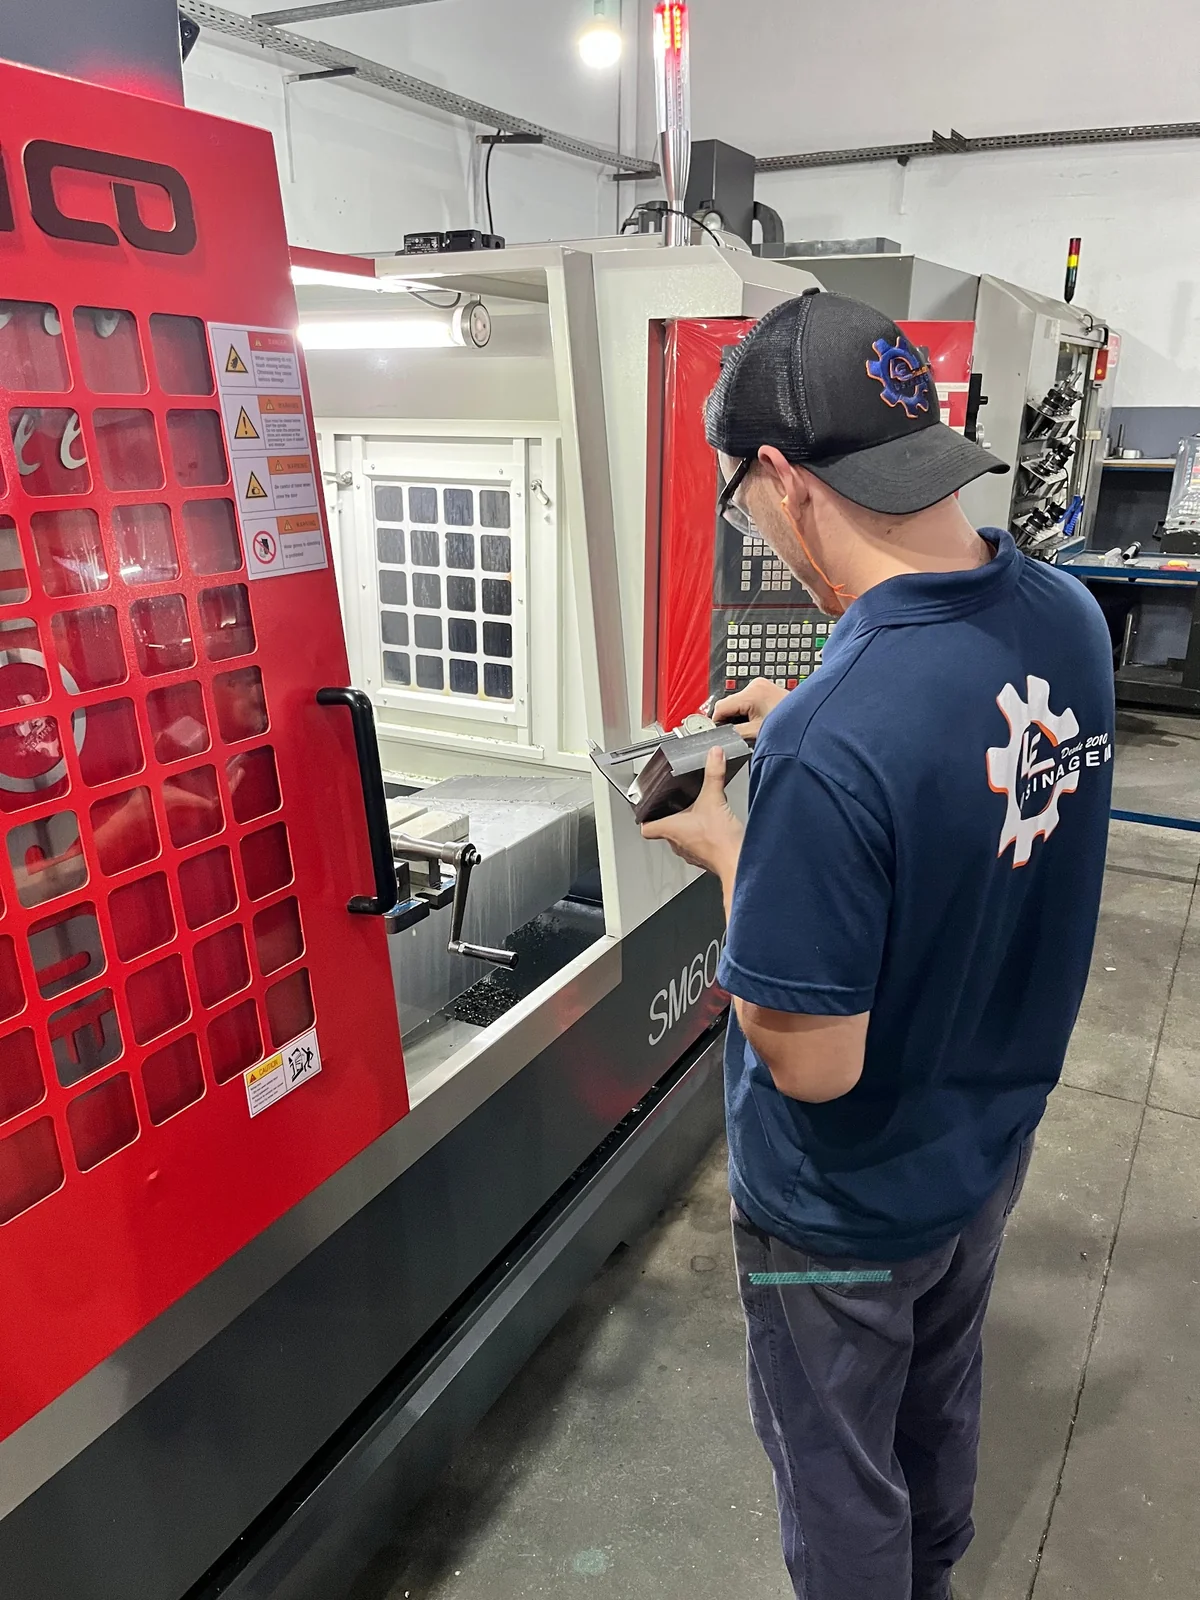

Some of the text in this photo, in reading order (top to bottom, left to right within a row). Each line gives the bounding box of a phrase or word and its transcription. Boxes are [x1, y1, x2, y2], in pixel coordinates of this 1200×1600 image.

[1061, 732, 1109, 760] Desde 2010
[258, 1059, 279, 1076] CAUTION
